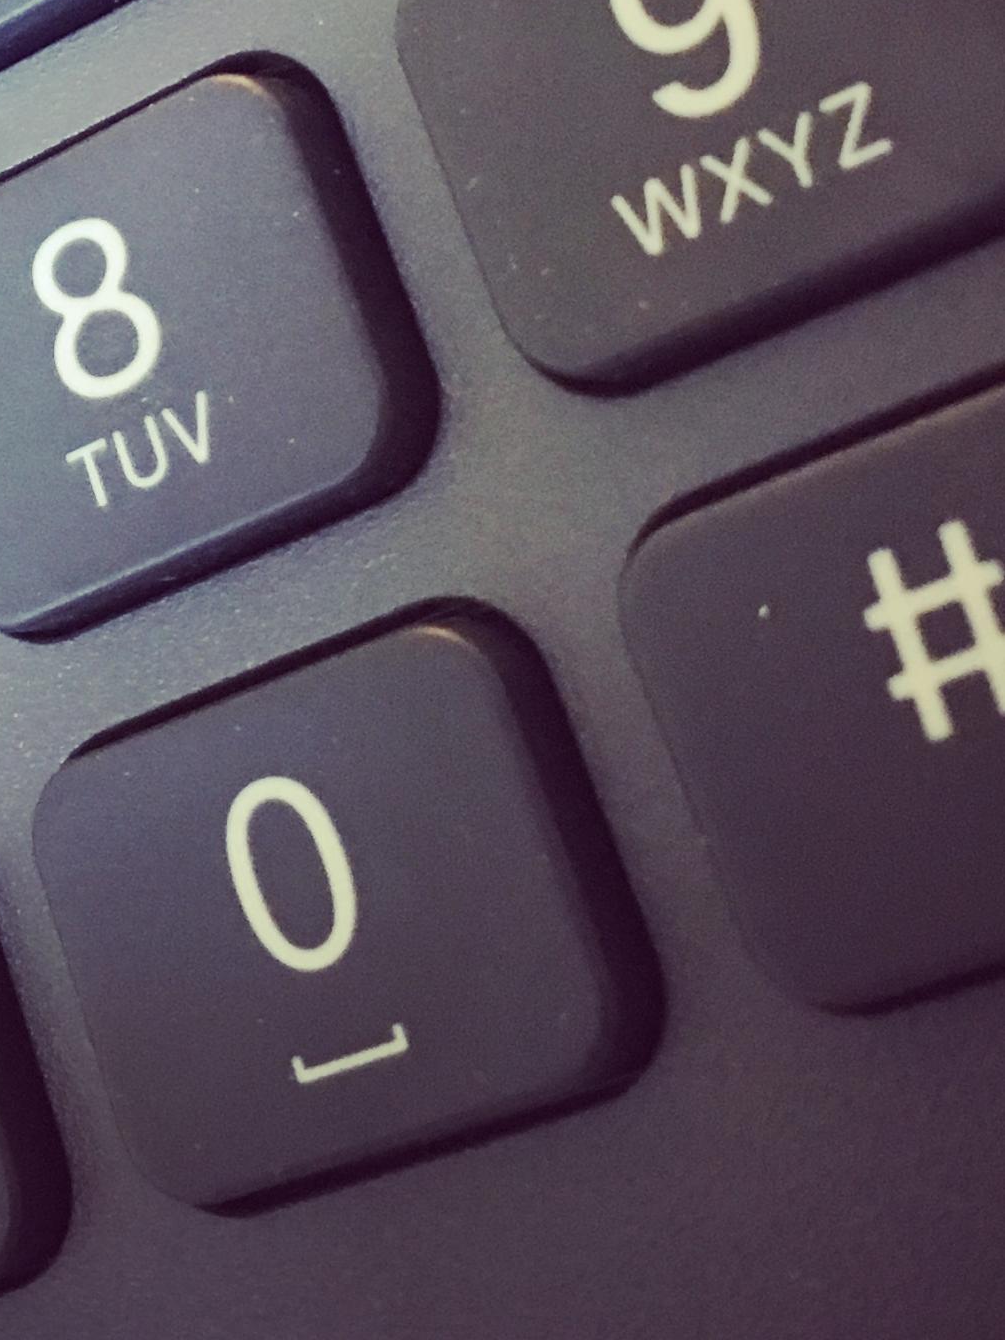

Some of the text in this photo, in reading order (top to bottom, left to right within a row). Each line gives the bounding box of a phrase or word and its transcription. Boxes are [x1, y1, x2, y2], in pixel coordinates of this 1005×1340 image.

[610, 80, 894, 257] WXYZ
[31, 217, 161, 400] 8
[64, 390, 211, 508] TUV
[224, 775, 358, 973] 0
